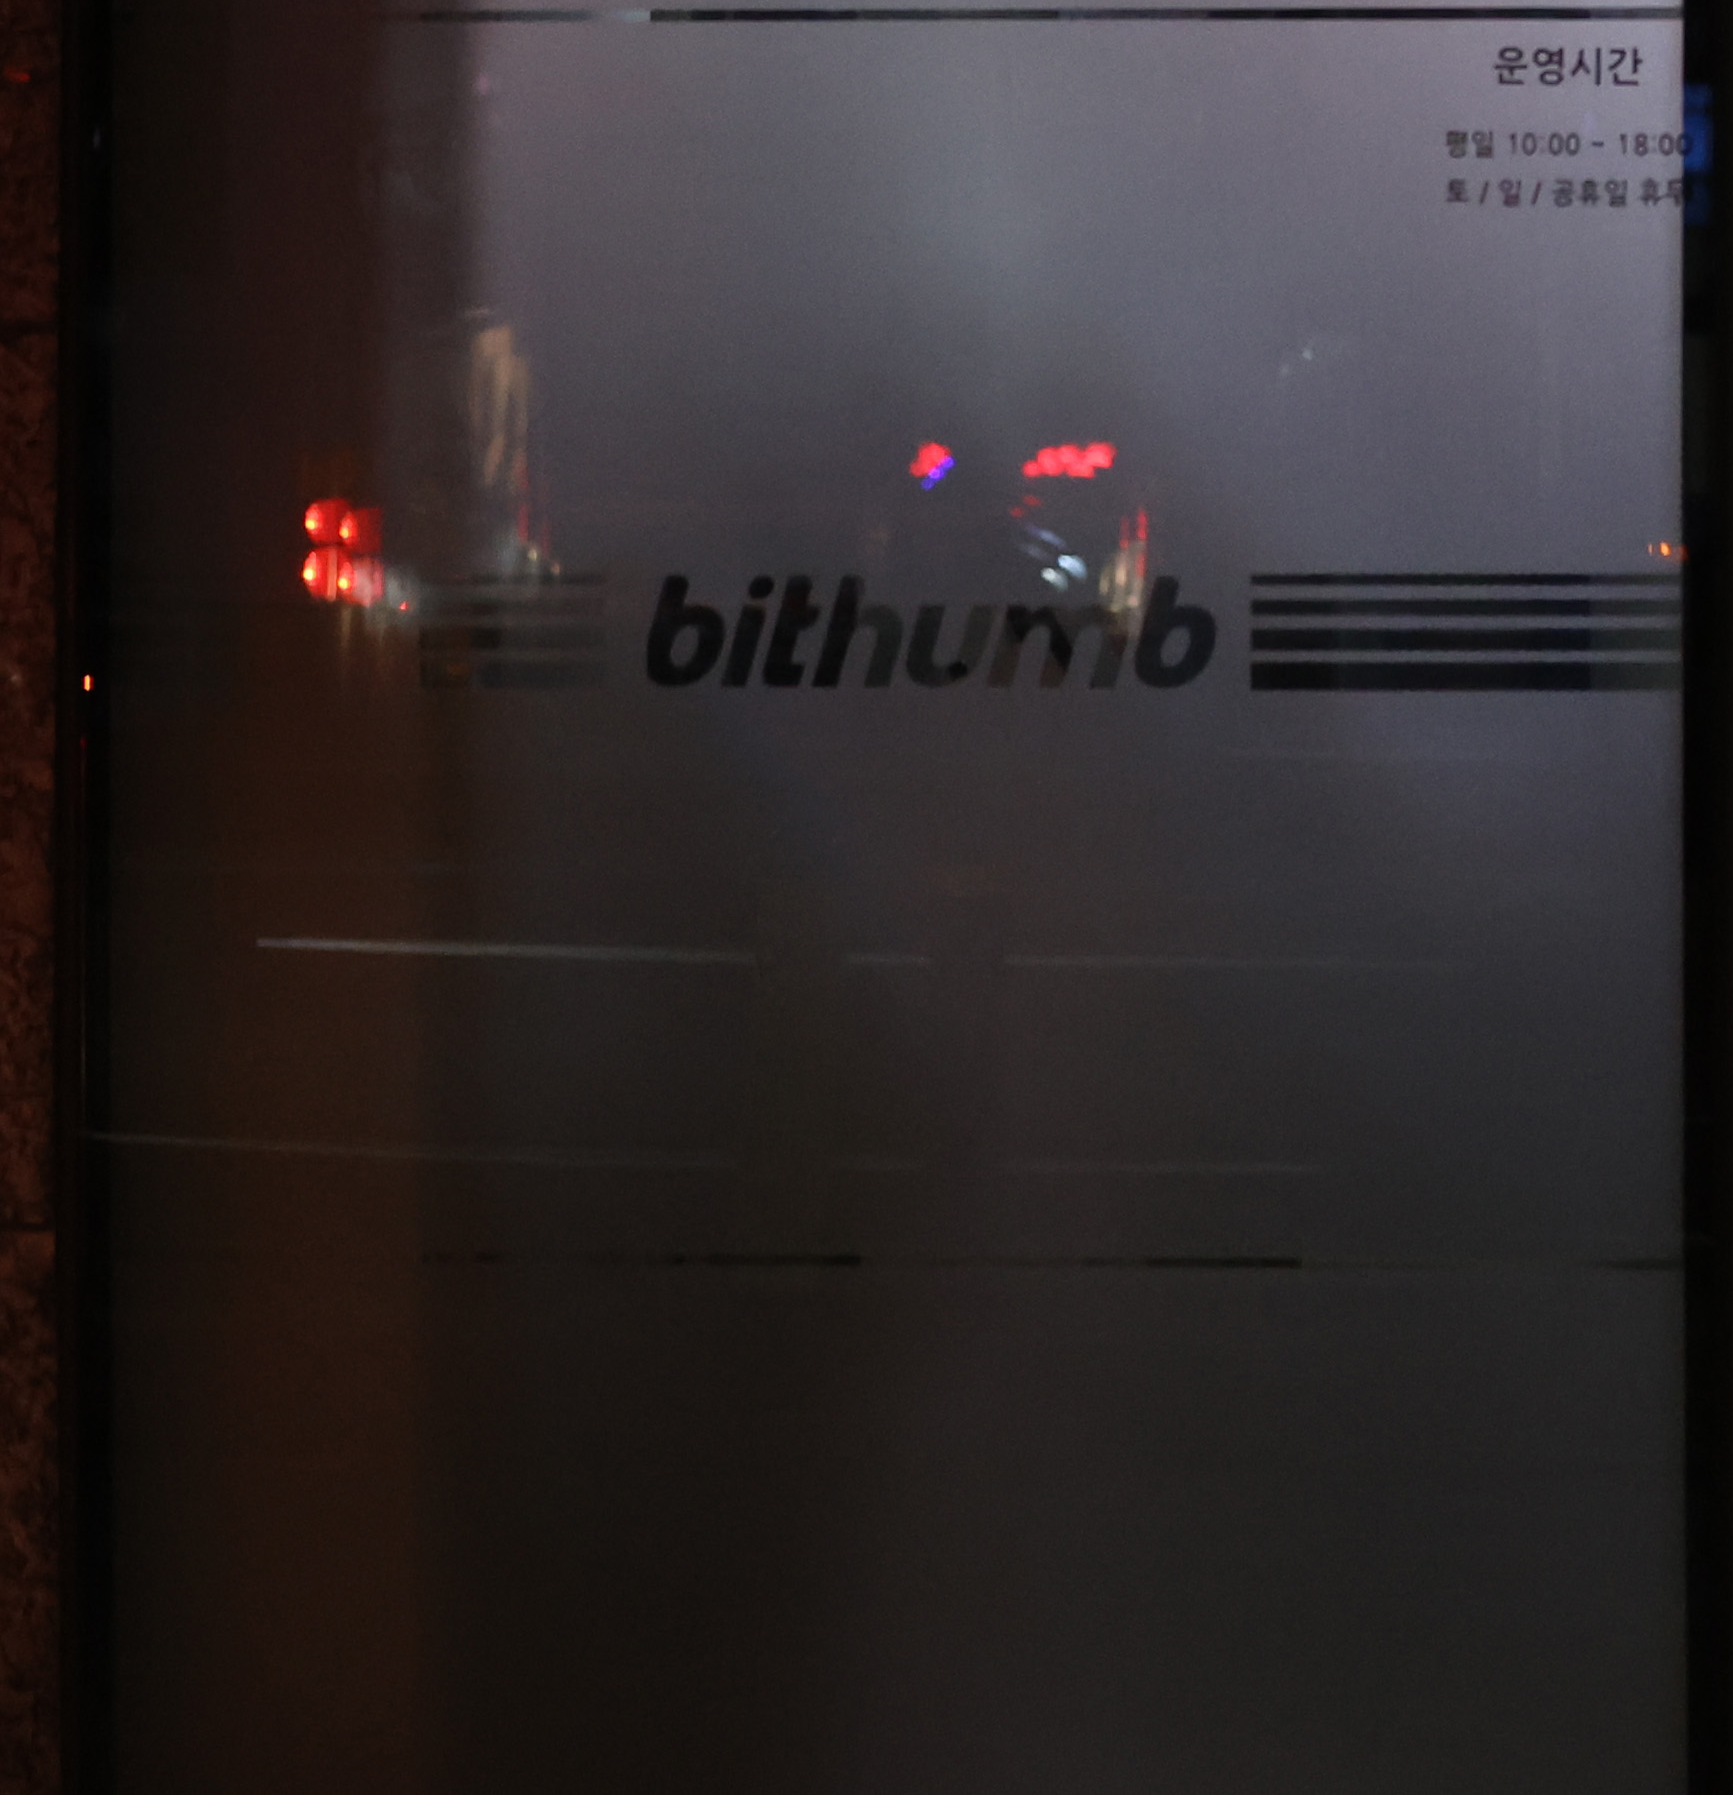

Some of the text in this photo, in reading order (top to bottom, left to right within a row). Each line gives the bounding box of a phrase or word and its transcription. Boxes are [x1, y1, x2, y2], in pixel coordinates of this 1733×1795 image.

[1494, 46, 1643, 86] 운영시간
[1446, 130, 1494, 158] 평일
[1552, 178, 1628, 208] 공휴일
[646, 574, 1217, 689] bithumb
